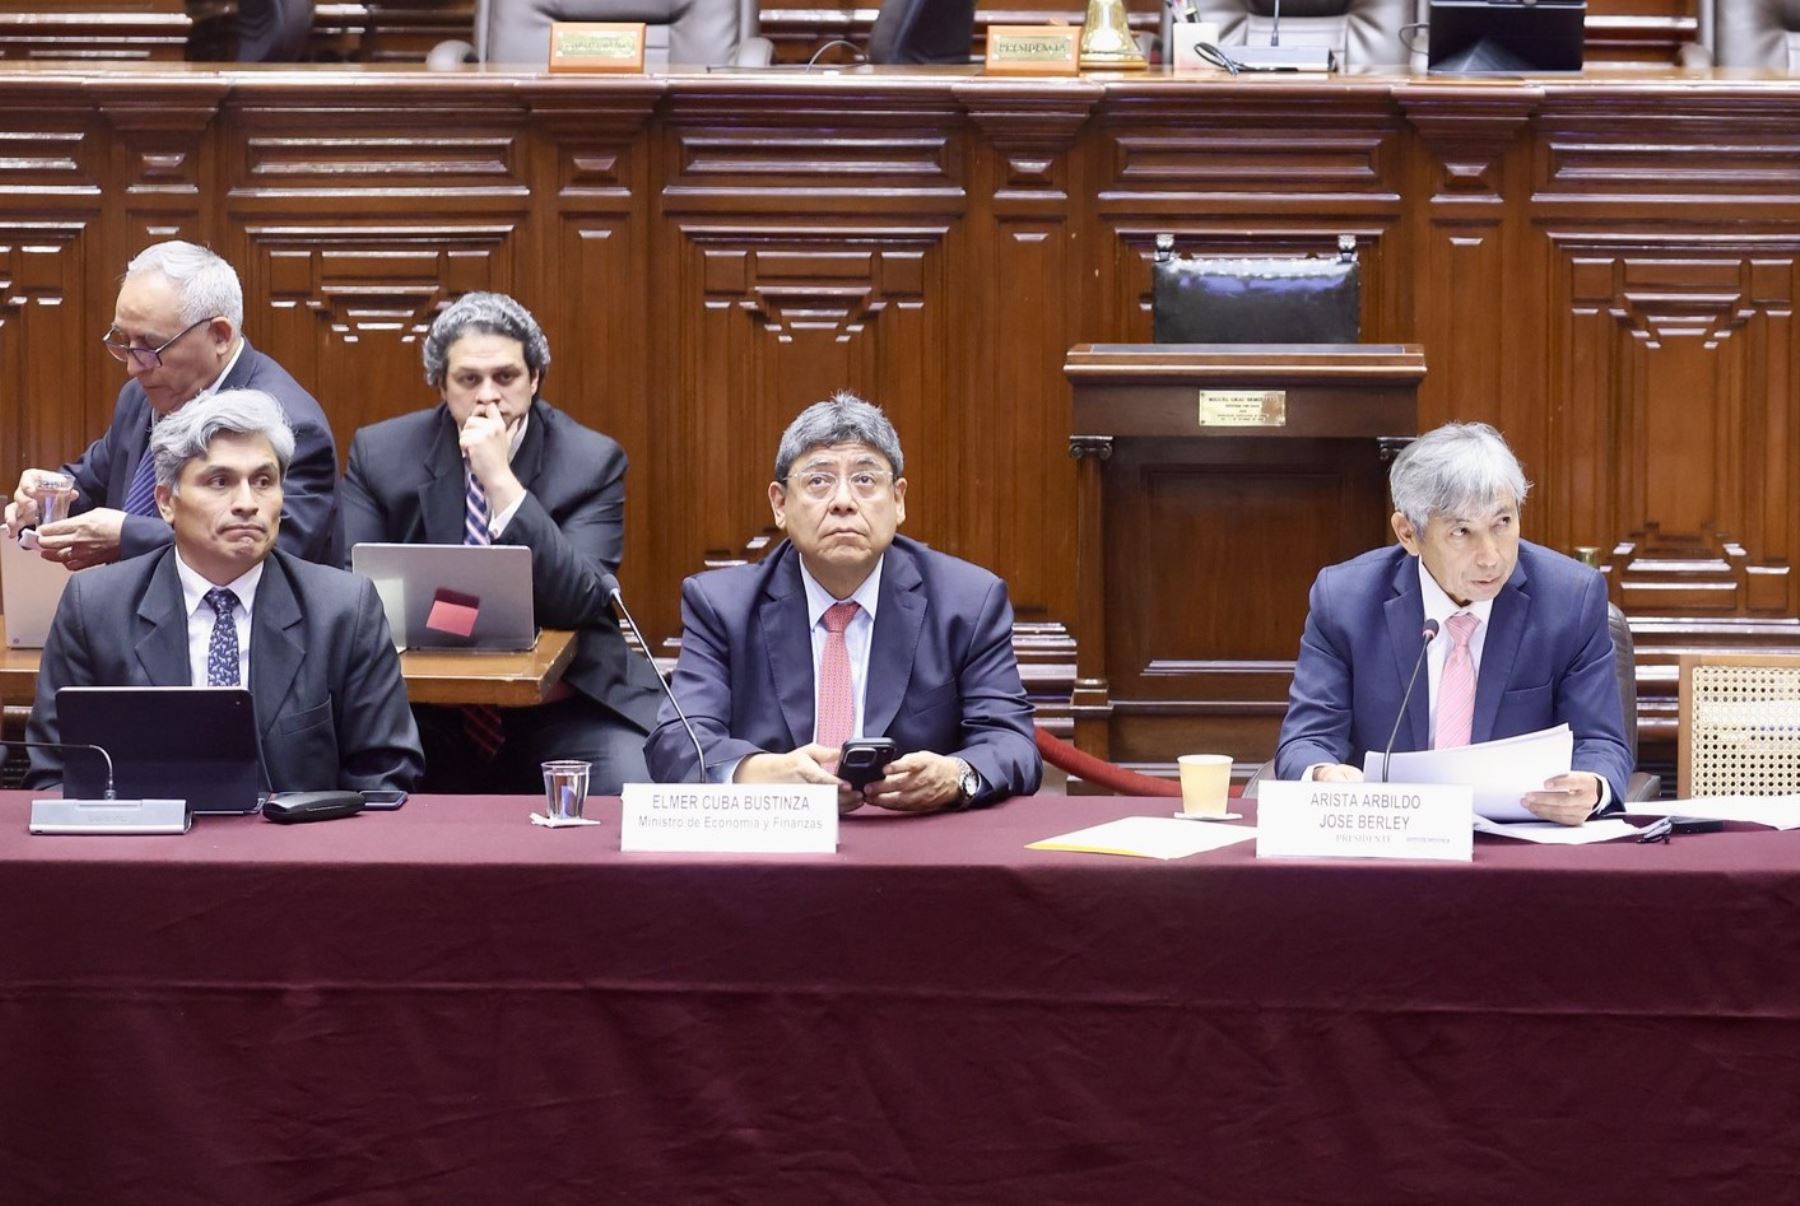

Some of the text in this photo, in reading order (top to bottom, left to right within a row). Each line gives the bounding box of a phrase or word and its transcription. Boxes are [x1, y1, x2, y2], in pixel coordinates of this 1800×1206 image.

[652, 794, 810, 811] ELMER CUBA BUSTINZA
[1310, 792, 1421, 809] ARISTA ARBILDO
[638, 815, 684, 828] Ministro
[687, 816, 700, 828] de
[762, 818, 771, 831] y
[772, 817, 823, 830] Finanzas
[1319, 814, 1410, 830] JOSE BERLEY
